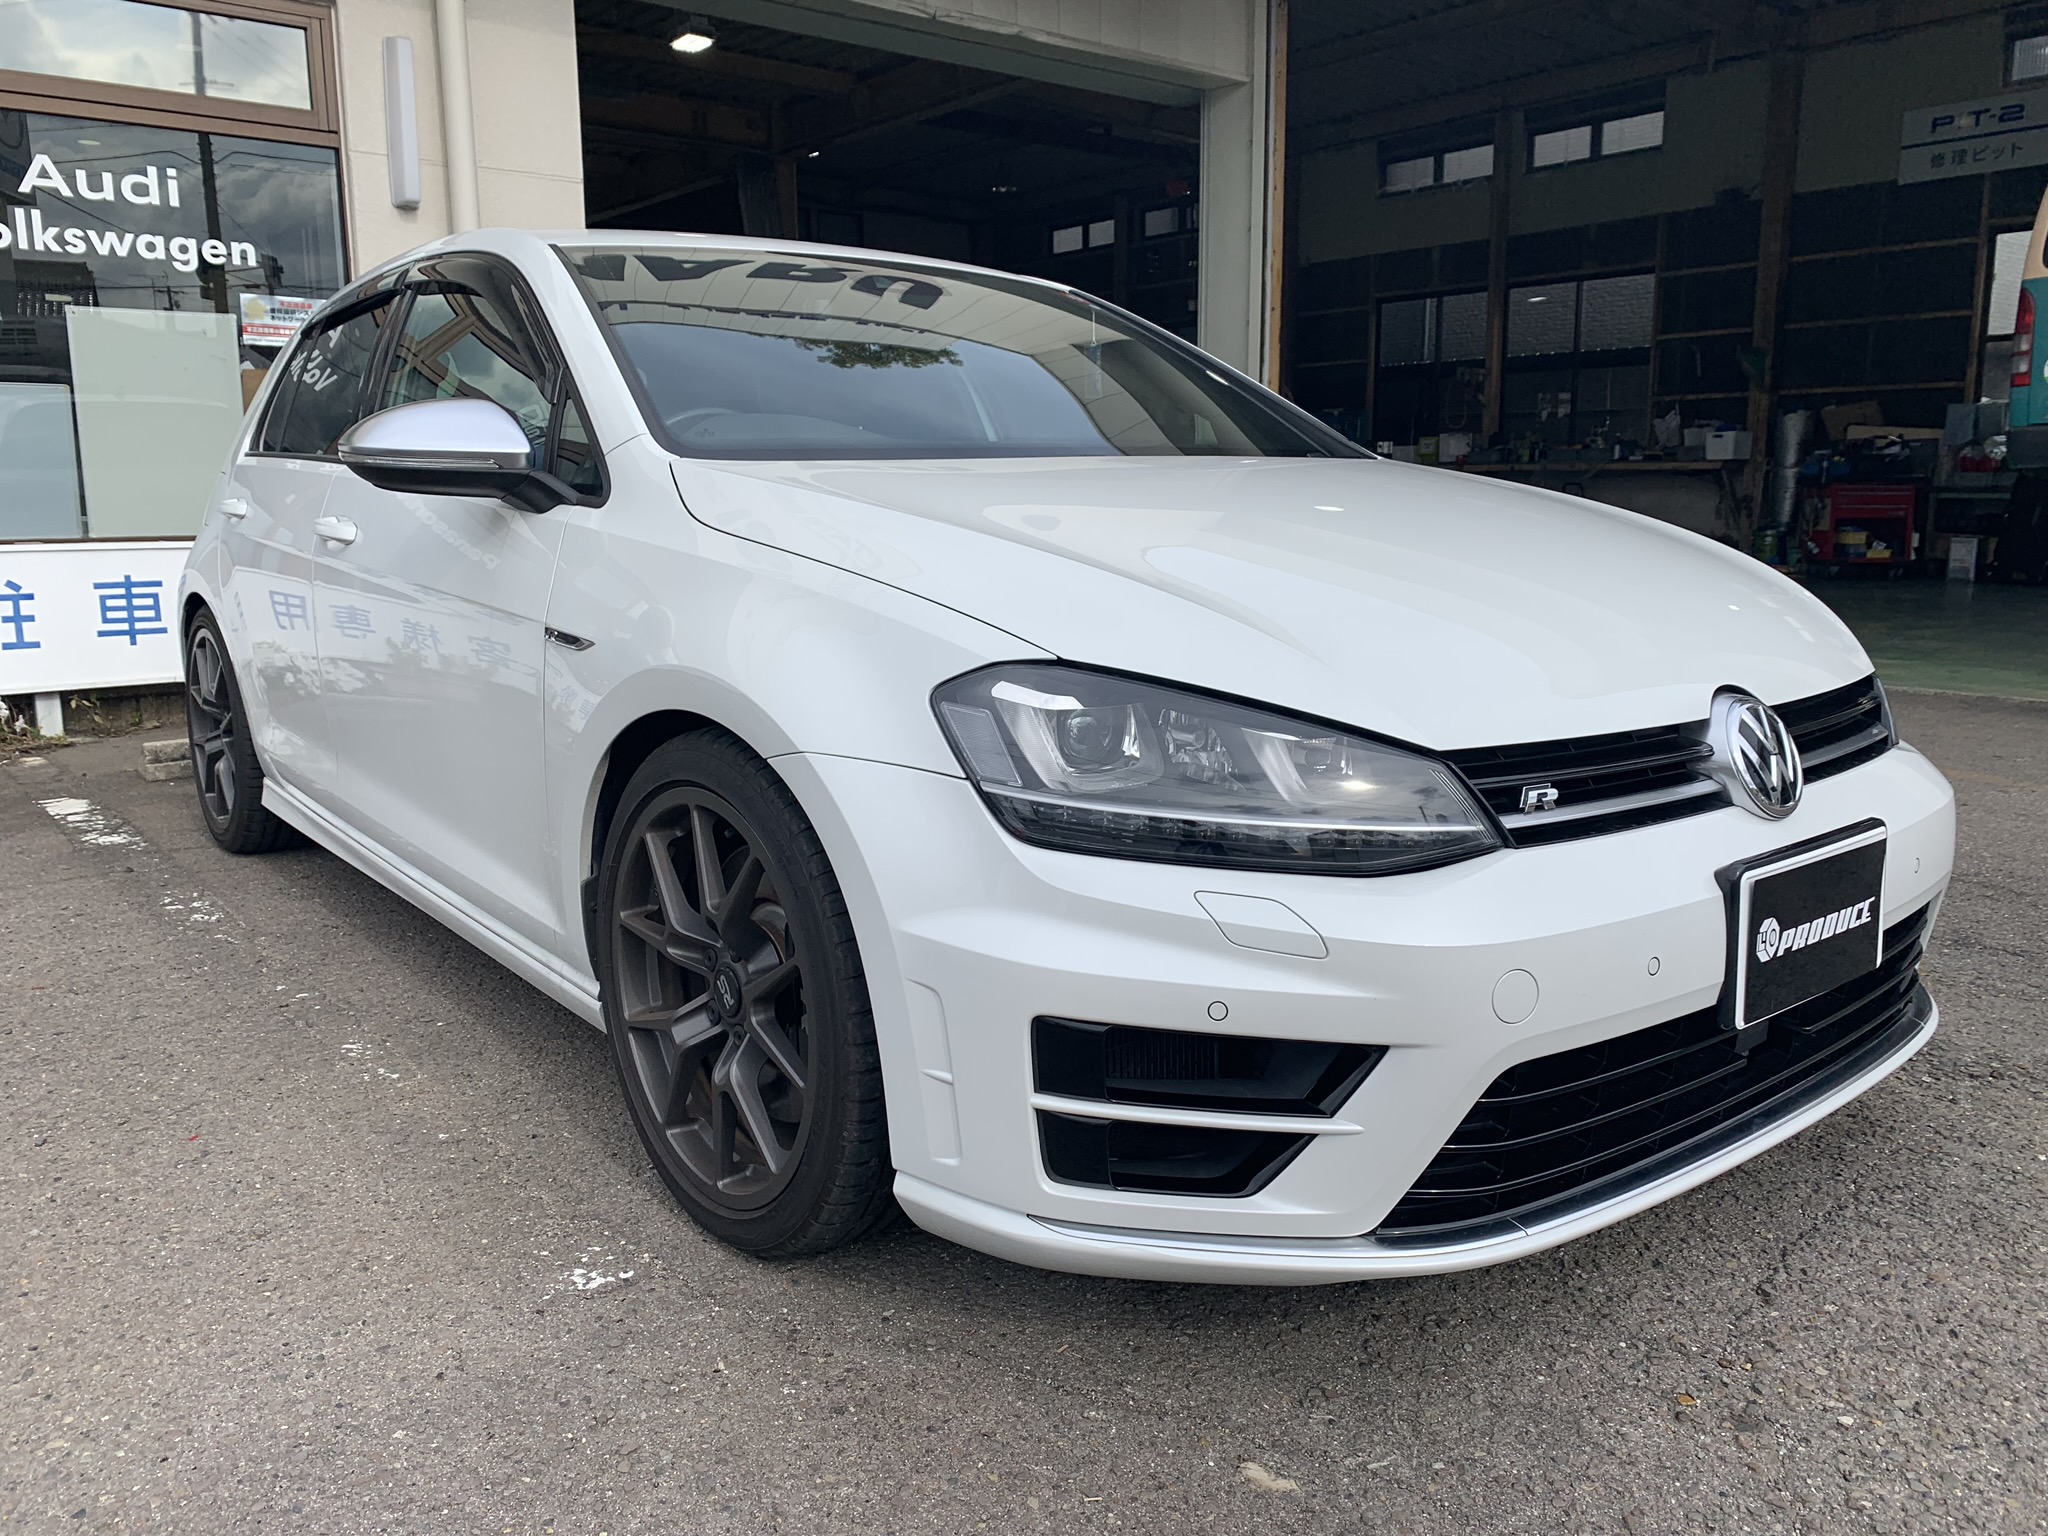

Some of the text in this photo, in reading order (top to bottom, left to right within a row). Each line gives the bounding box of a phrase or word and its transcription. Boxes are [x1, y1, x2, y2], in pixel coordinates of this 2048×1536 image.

[1931, 104, 2025, 133] PT-2
[18, 153, 181, 208] Audi
[1519, 783, 1559, 815] R
[1776, 896, 1875, 957] PRODUCE
